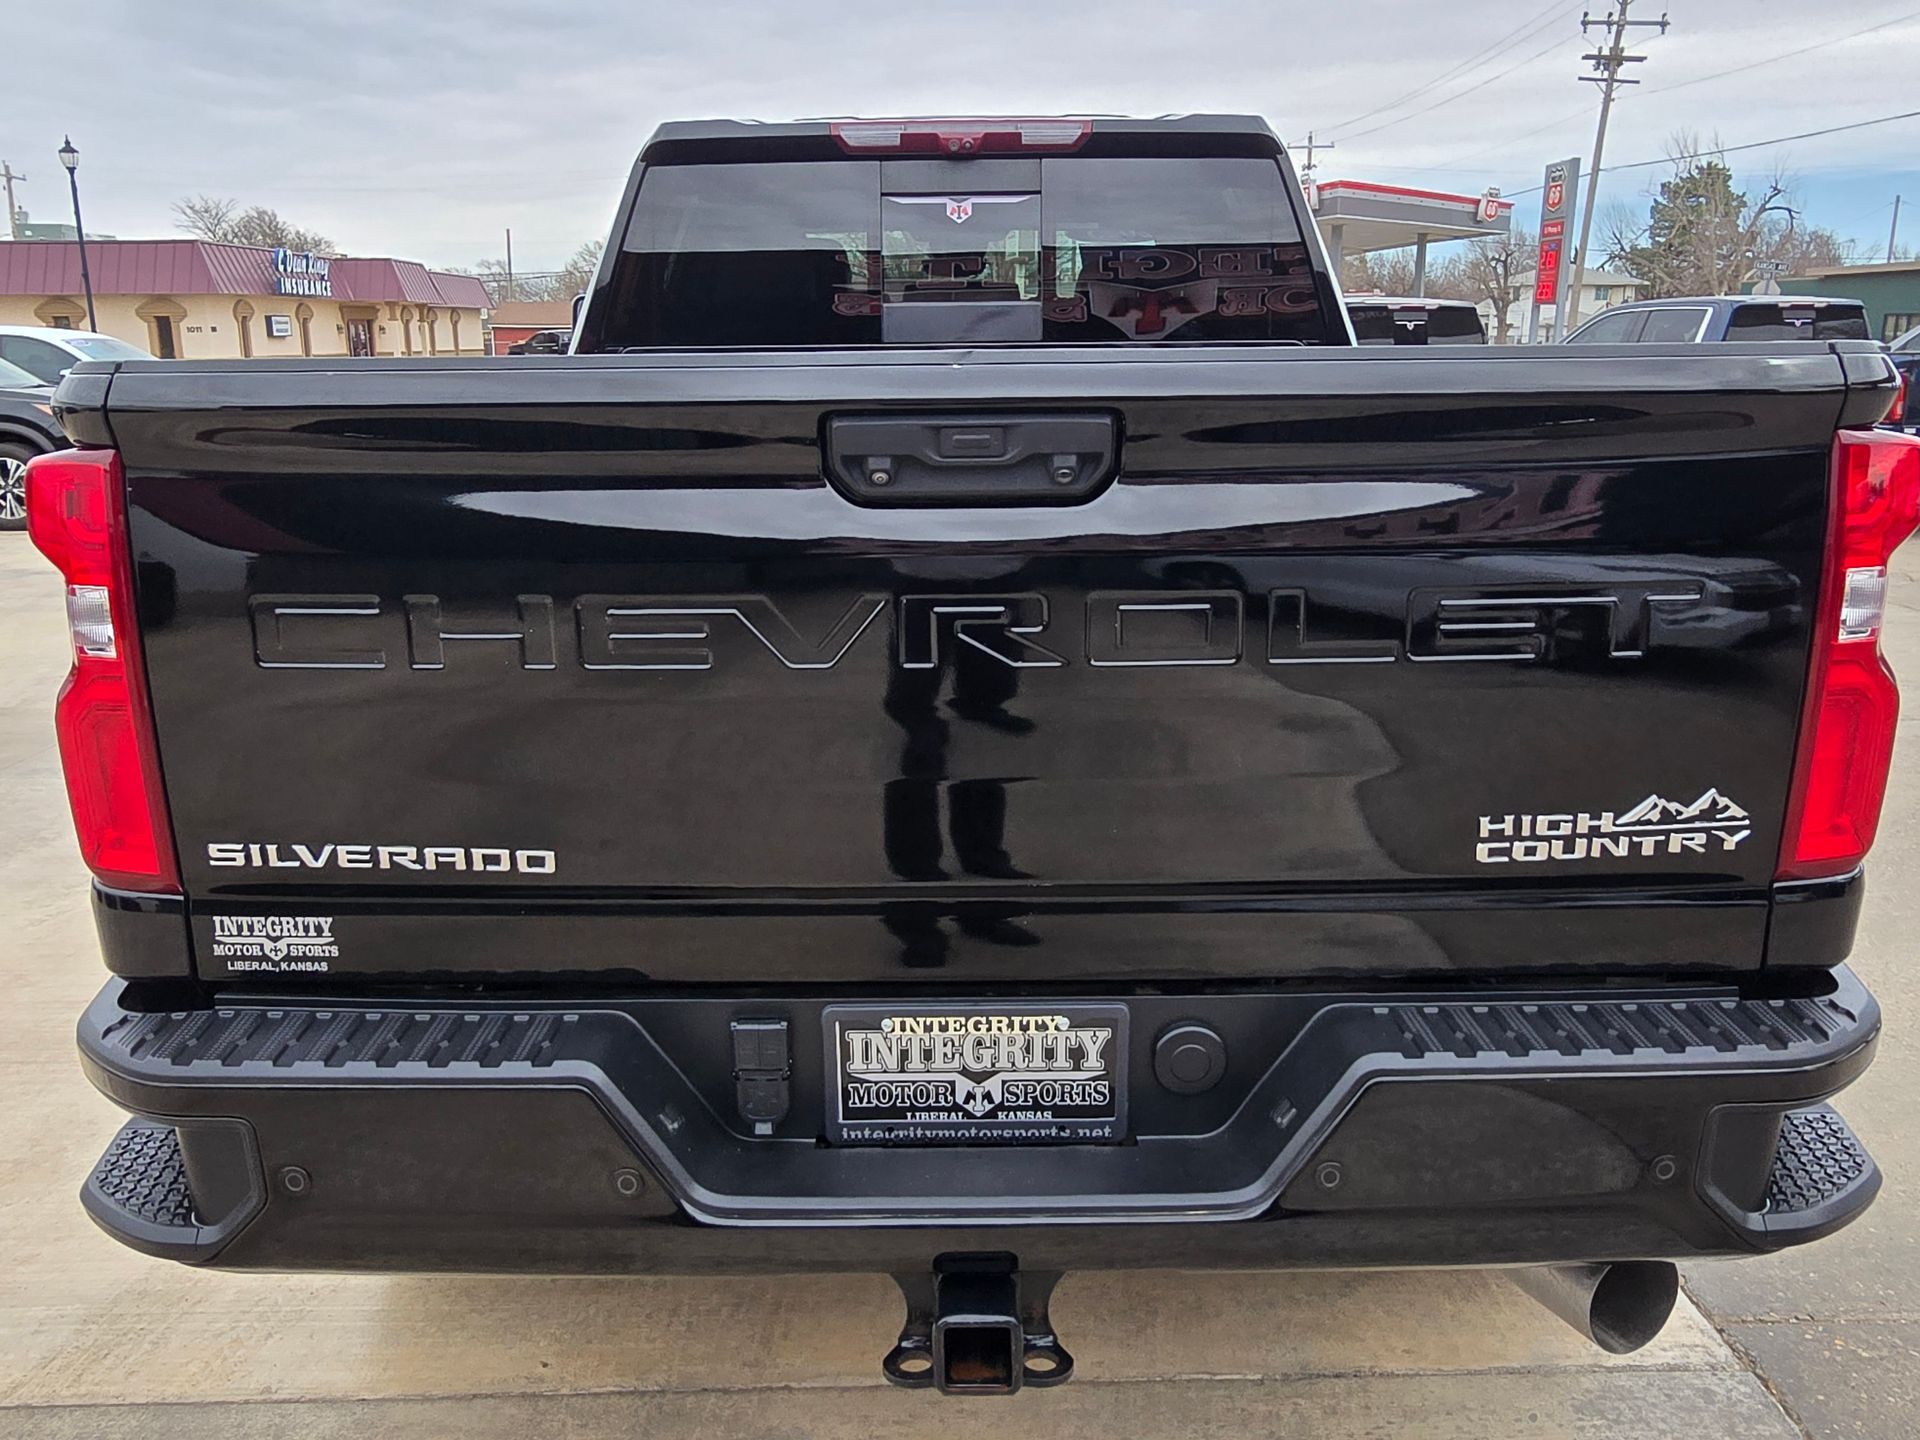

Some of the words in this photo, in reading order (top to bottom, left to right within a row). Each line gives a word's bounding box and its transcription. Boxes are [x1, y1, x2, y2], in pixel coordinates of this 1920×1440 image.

[1548, 186, 1561, 204] 66
[1487, 201, 1498, 216] 66
[280, 277, 332, 297] INSURANCE
[248, 581, 1705, 670] CHEVROLET
[1479, 812, 1615, 838] HIGH
[1476, 830, 1751, 863] COUNTRY
[207, 843, 556, 874] SILVERADO
[213, 915, 334, 938] INTEGRITY
[213, 944, 263, 957] MOTOR
[289, 944, 339, 957] SPORTS
[227, 961, 279, 973] LIBERAL,
[280, 961, 328, 972] KANSAS
[892, 1016, 1062, 1035] INTEGRITY
[846, 1028, 1112, 1073] INTEGRITY
[848, 1082, 954, 1107] MOTOR
[1003, 1080, 1110, 1106] SPORTS
[906, 1112, 967, 1120] LIBERAL
[997, 1111, 1053, 1120] KANSAS
